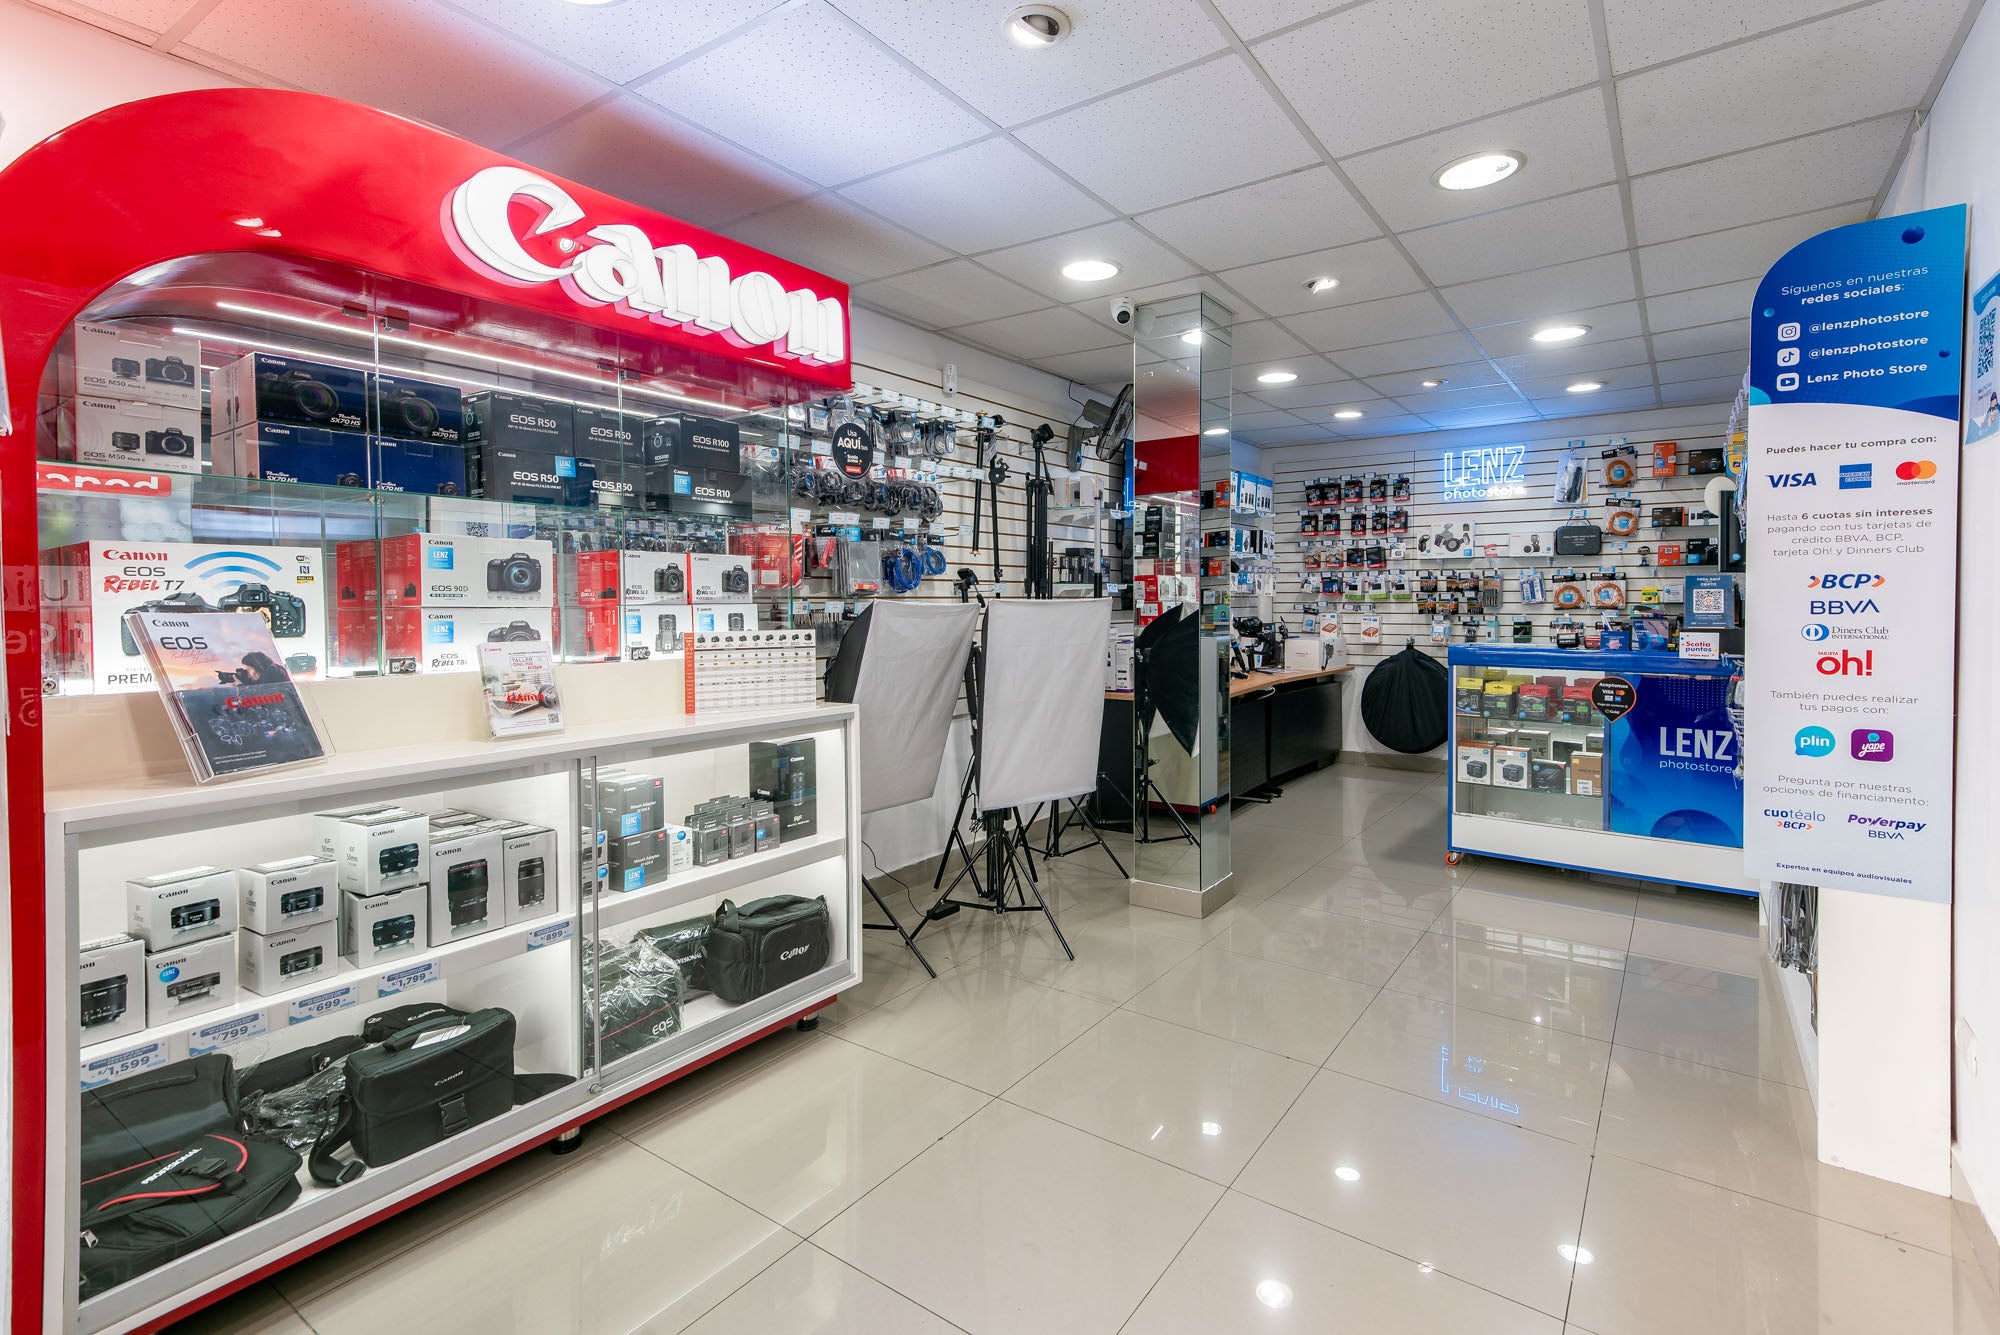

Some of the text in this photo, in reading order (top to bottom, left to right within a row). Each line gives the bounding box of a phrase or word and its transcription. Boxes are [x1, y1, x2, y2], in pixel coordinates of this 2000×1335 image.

[449, 165, 845, 364] Canon
[1781, 266, 1929, 296] Síguenos en nuestras
[1801, 282, 1905, 305] redes sociales:
[1808, 310, 1930, 333] @lenzphotostore
[82, 326, 116, 336] Canon
[1808, 336, 1929, 359] @lenzphotostore
[260, 357, 286, 366] Canon
[1807, 363, 1928, 384] Lenz Photo Store
[84, 376, 106, 384] EOS
[108, 379, 126, 387] M50
[82, 400, 116, 410] Canon
[330, 417, 349, 426] SX70
[510, 414, 556, 428] EOS R50
[265, 426, 290, 435] Canon
[590, 426, 613, 437] EOS
[615, 430, 632, 441] R50
[693, 436, 729, 448] EOS R100
[838, 436, 861, 450] AQUÍ
[1766, 436, 1937, 455] Puedes hacer tu compra con:
[108, 452, 126, 460] M50
[1443, 445, 1526, 488] LENZ
[513, 472, 559, 484] EOS R50
[1765, 472, 1817, 488] VISA
[592, 480, 632, 492] EOS R50
[695, 487, 730, 498] EOS R10
[1444, 486, 1526, 501] photostore
[1767, 514, 1798, 522] Hasta
[1812, 510, 1852, 520] cuotas
[1855, 509, 1872, 517] sin
[1876, 507, 1933, 517] intereses
[1768, 524, 1816, 535] pagando
[1845, 522, 1863, 530] tus
[1866, 520, 1912, 531] tarjetas
[1916, 520, 1932, 528] de
[1792, 534, 1832, 544] crédito
[102, 550, 168, 561] Canon
[1773, 548, 1809, 558] tarjeta
[1813, 548, 1833, 556] Oh!
[1847, 547, 1892, 555] Dinners
[1896, 545, 1924, 553] Club
[124, 566, 166, 577] EOS
[165, 580, 184, 591] T7
[1822, 574, 1871, 589] BCP
[1810, 599, 1880, 615] BBVA
[152, 619, 190, 628] Canon
[1831, 626, 1889, 634] Diners Club
[160, 637, 208, 650] EOS
[1816, 649, 1873, 676] oh!
[108, 673, 152, 685] PREM
[225, 693, 284, 709] Canon
[507, 693, 544, 703] Canon
[1770, 690, 1919, 705] También puedes realizar
[1800, 703, 1817, 711] tus
[1821, 705, 1859, 714] pagos
[1659, 726, 1733, 762] LENZ
[1800, 735, 1830, 748] plin
[1858, 742, 1886, 758] yape
[1659, 760, 1733, 774] photostore
[1778, 775, 1912, 793] Pregunta por nuestras
[1763, 785, 1814, 797] opciones
[1818, 789, 1832, 797] de
[1764, 808, 1826, 822] cuotéalo
[1783, 821, 1806, 830] BCP
[1848, 814, 1927, 832] Powerpay
[372, 829, 394, 837] Canon
[1868, 830, 1904, 840] BBVA
[436, 847, 462, 857] Canon
[509, 842, 530, 850] Canon
[1776, 863, 1809, 871] Expertos
[1823, 868, 1855, 877] equipos
[1857, 872, 1912, 884] audiovisuales
[271, 876, 297, 886] Canon
[158, 889, 188, 899] Canon
[365, 901, 388, 910] Canon
[270, 937, 296, 947] Canon
[156, 957, 186, 969] Canon
[652, 1017, 673, 1035] EOS
[434, 1070, 463, 1086] Canon
